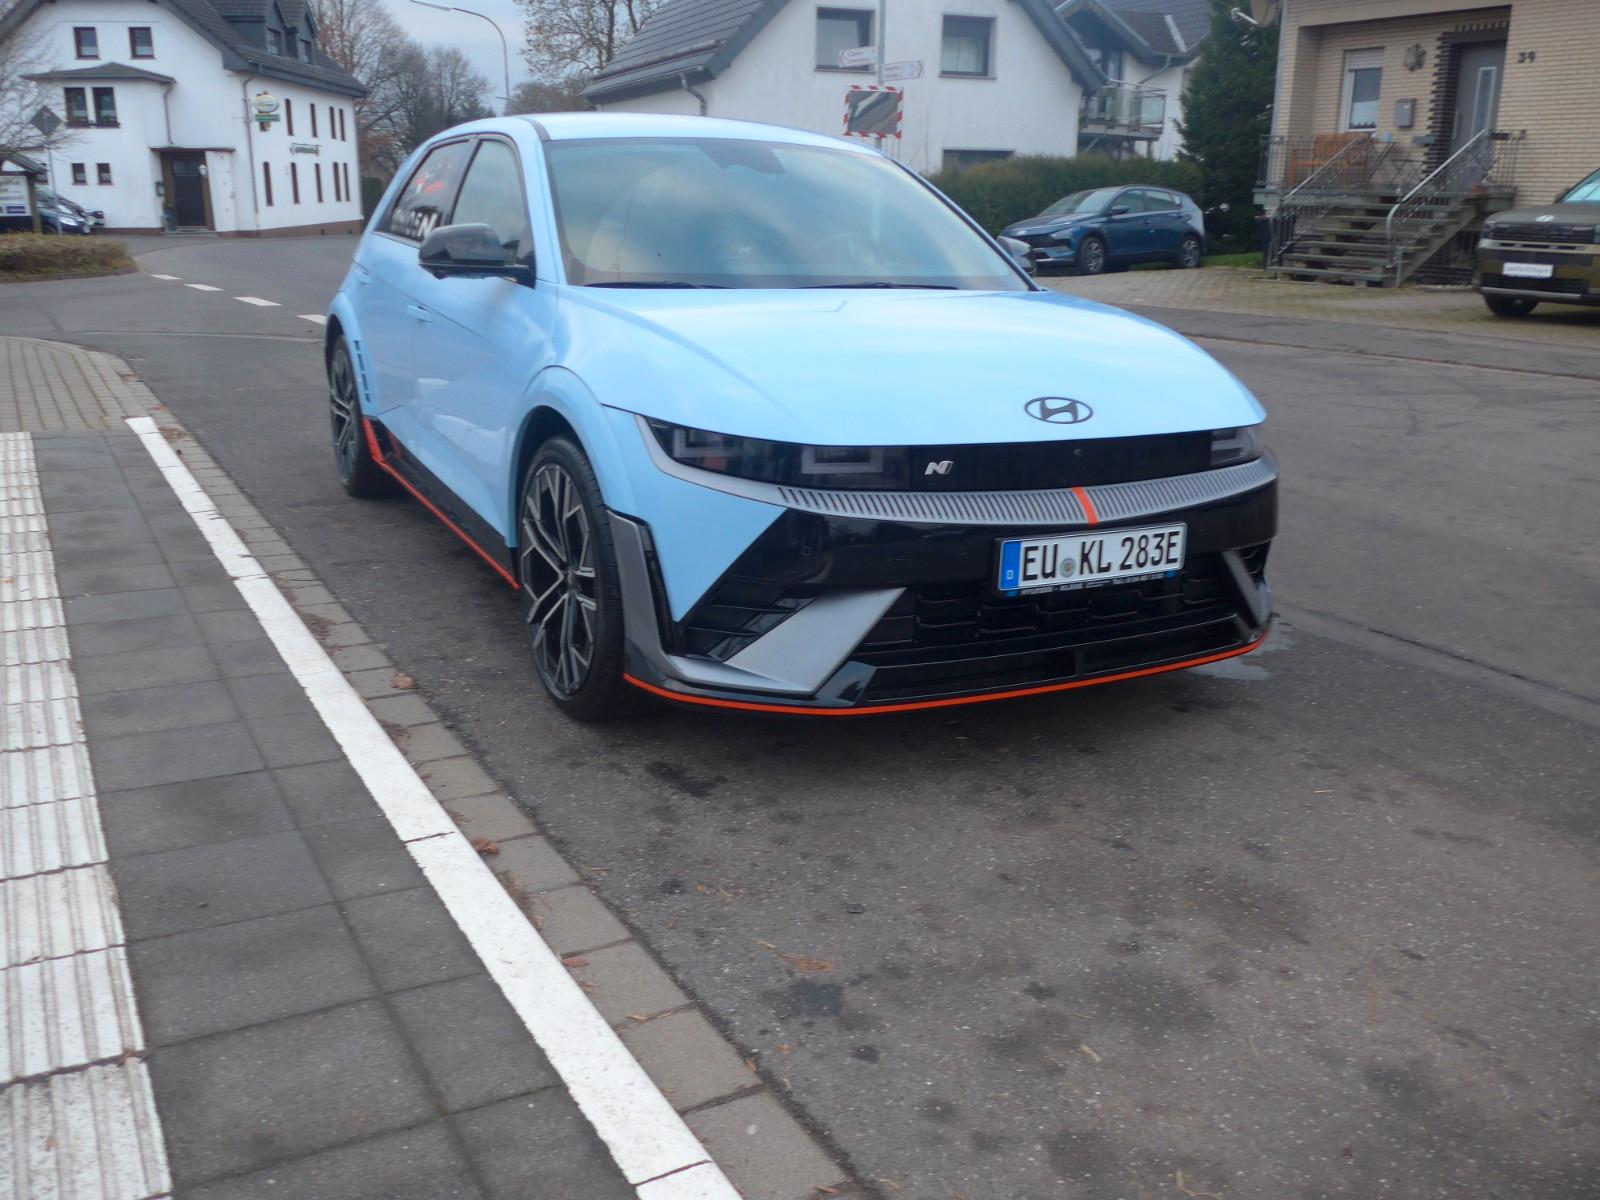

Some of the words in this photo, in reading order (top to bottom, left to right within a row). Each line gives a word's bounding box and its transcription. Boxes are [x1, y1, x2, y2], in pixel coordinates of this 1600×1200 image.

[1517, 51, 1536, 64] 39
[1022, 543, 1059, 582] EU
[1079, 539, 1112, 576] KL
[1119, 530, 1181, 571] 283E
